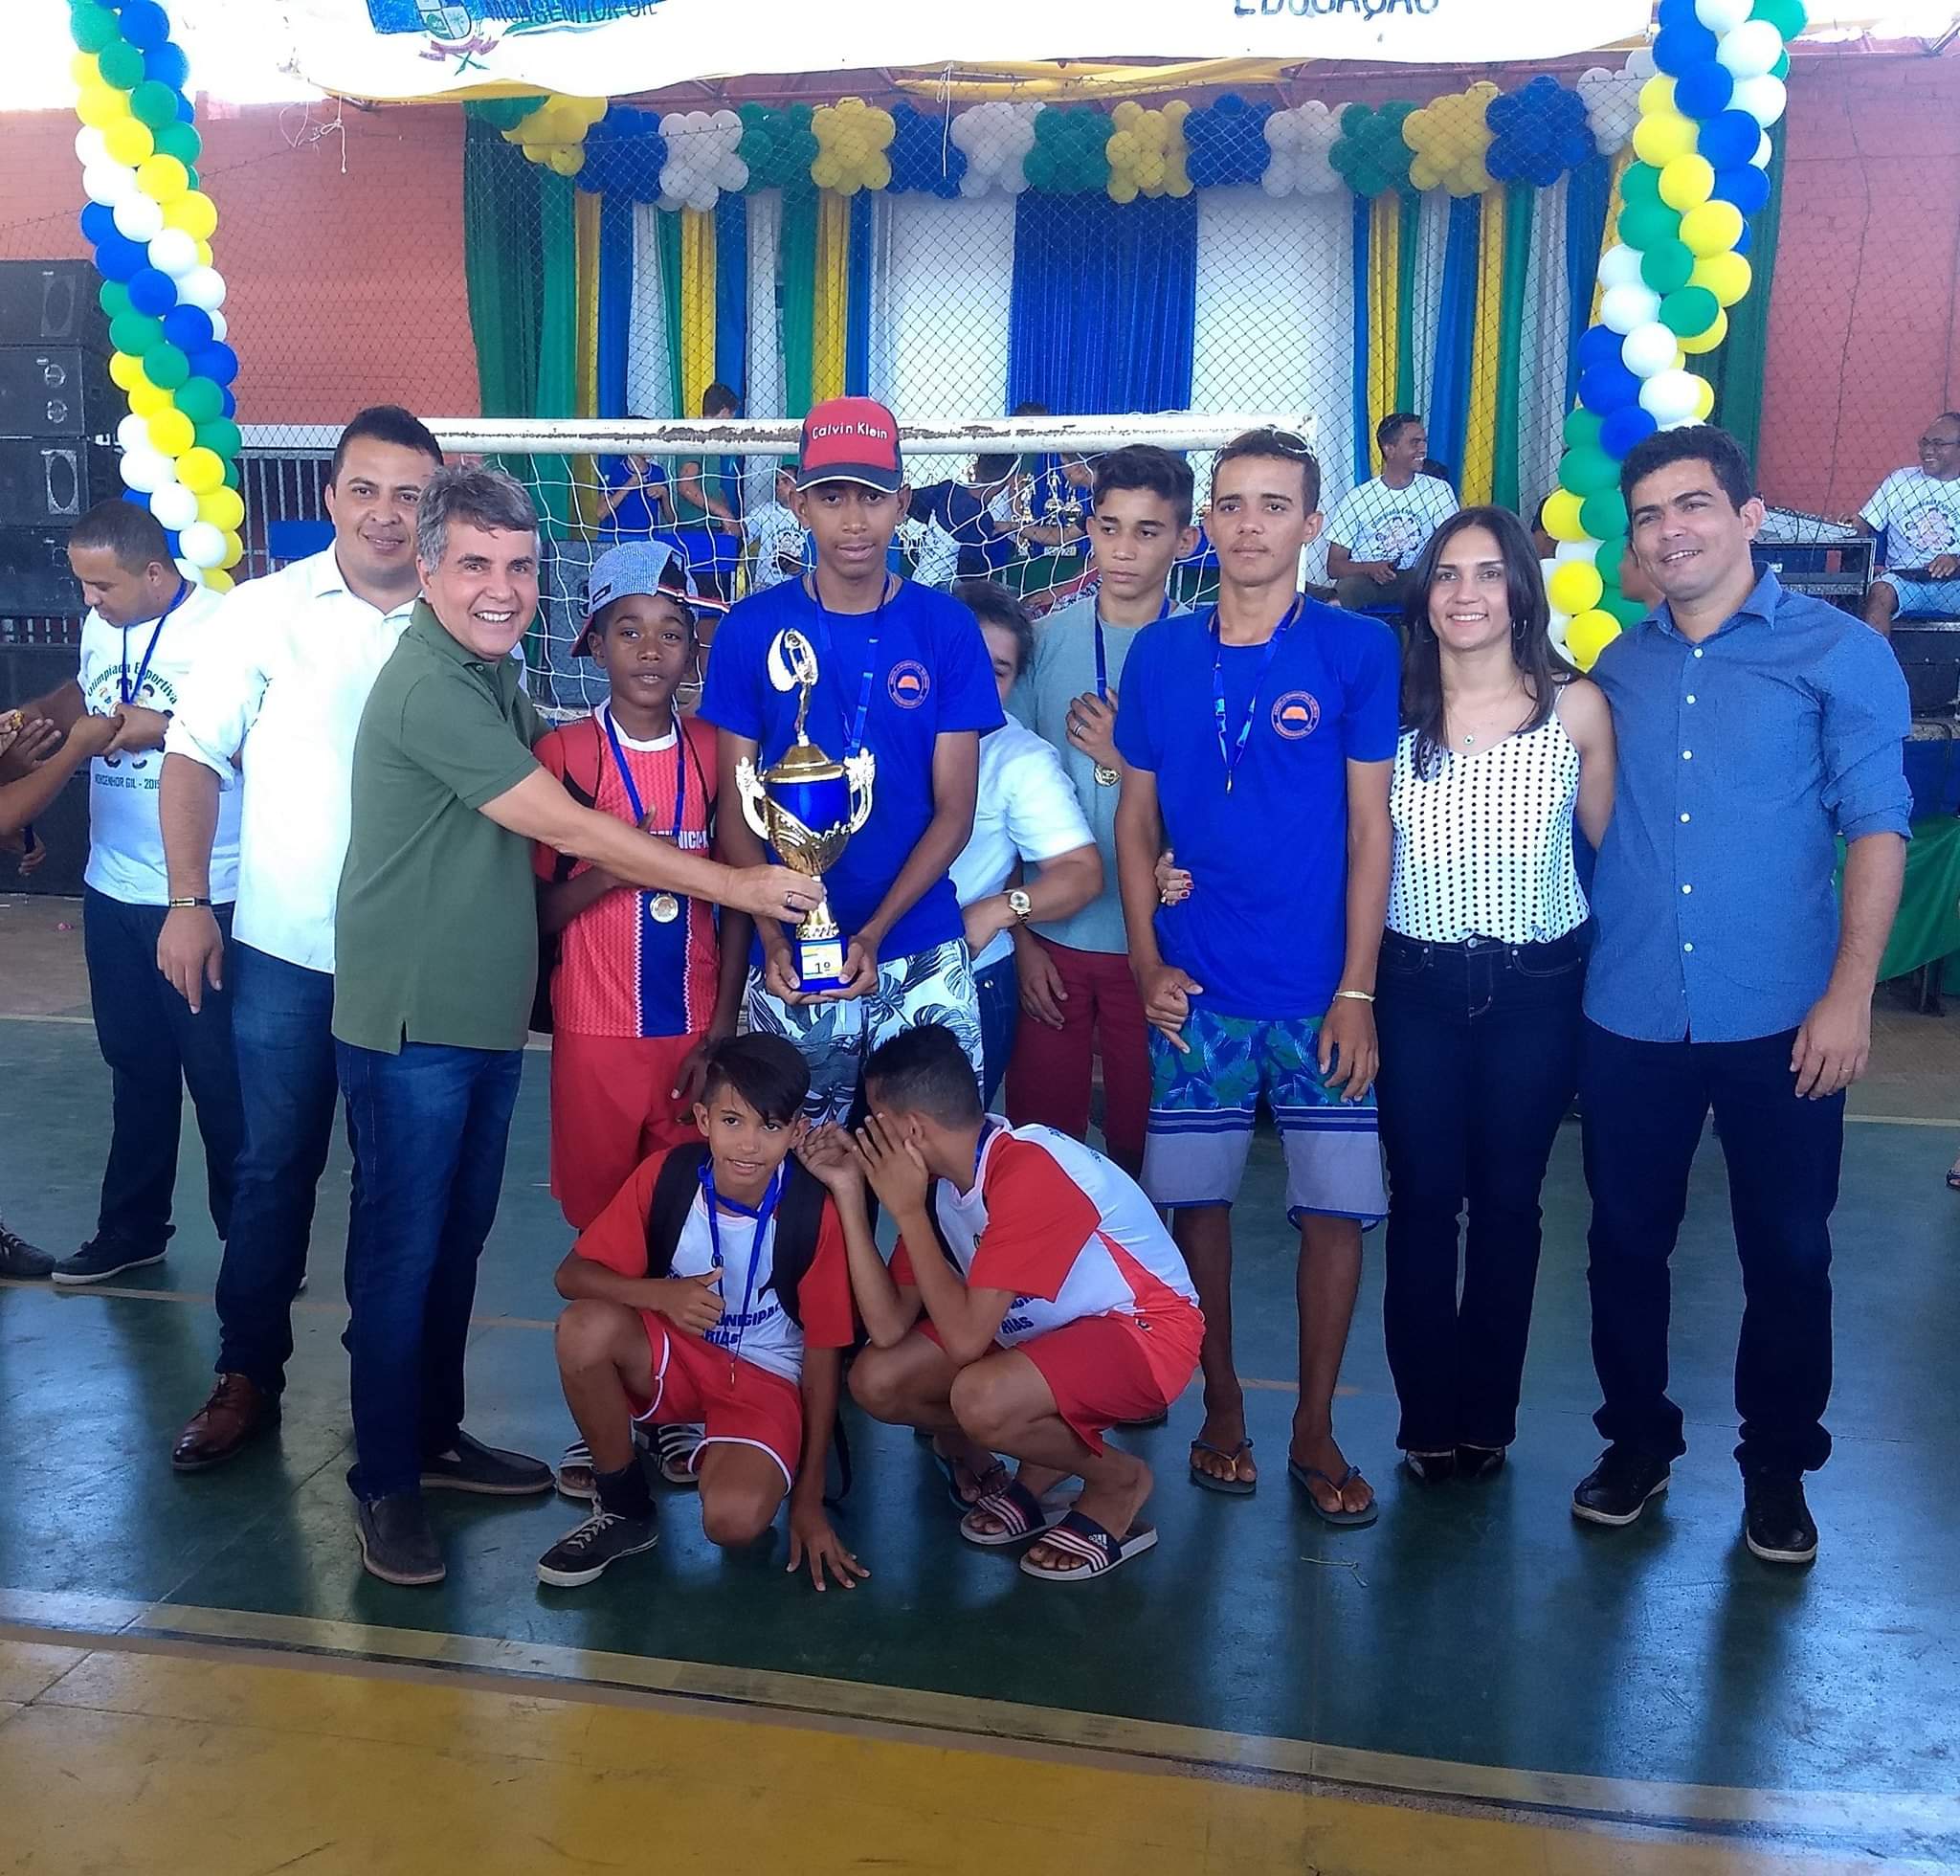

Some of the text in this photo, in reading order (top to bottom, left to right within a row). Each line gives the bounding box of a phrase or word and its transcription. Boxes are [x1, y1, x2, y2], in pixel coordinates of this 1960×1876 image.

[813, 422, 888, 440] Calvin Klein
[134, 661, 178, 705] Eportiva
[125, 776, 137, 790] GIL
